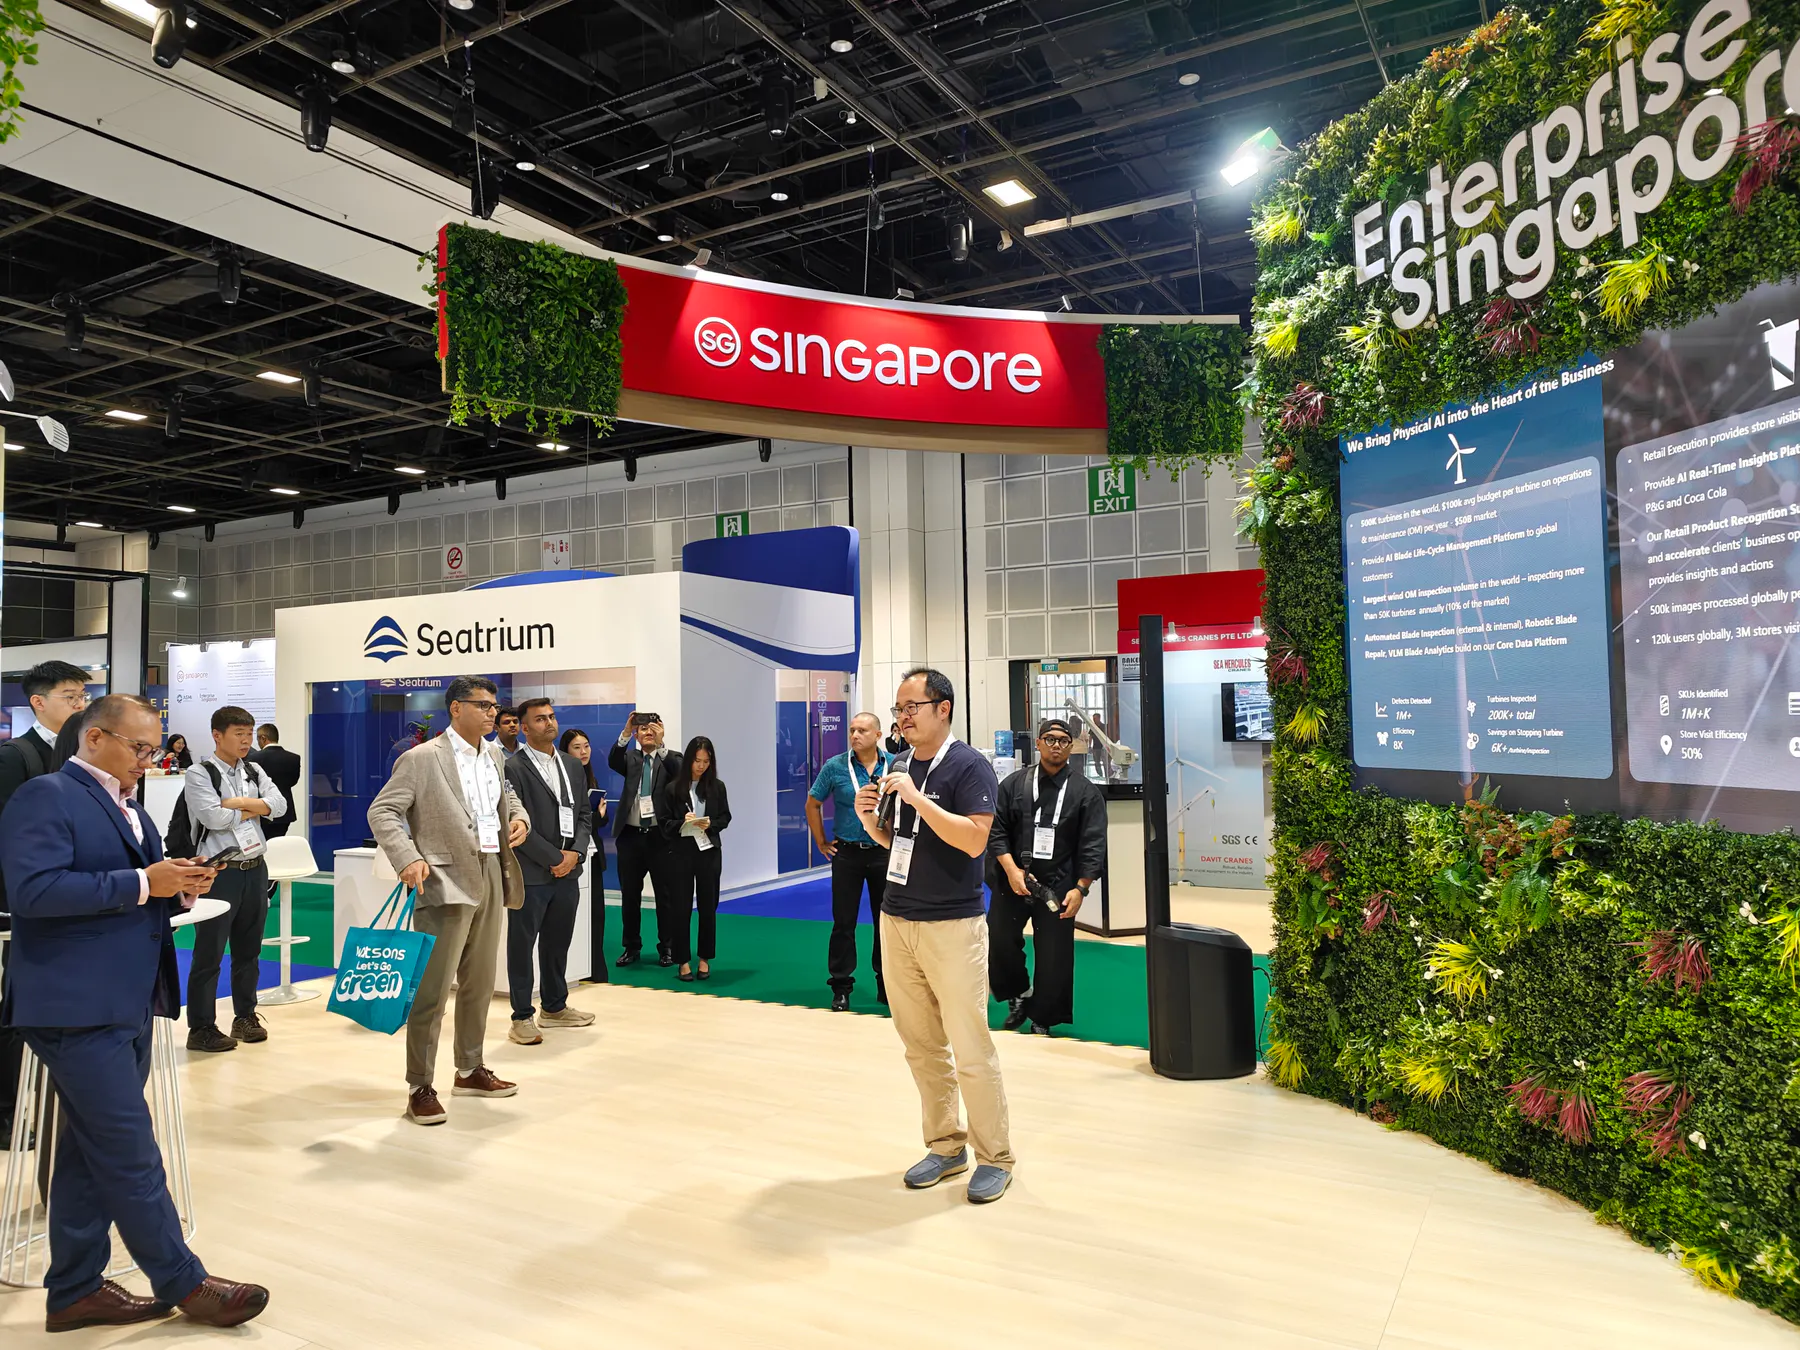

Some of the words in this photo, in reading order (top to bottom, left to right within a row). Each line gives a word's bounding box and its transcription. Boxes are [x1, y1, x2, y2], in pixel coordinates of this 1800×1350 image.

[1353, 0, 1751, 285] Enterprise
[1392, 37, 1800, 330] Singapor
[1347, 441, 1363, 453] We
[1365, 433, 1391, 448] Bring
[1393, 418, 1432, 440] Physical
[1447, 409, 1468, 424] into
[1471, 402, 1489, 416] the
[1491, 389, 1522, 410] Heart
[1525, 382, 1538, 399] of
[1539, 379, 1559, 394] the
[1562, 359, 1615, 387] Business
[1643, 447, 1666, 462] Retail
[1667, 437, 1708, 456] Execution
[1710, 426, 1750, 447] provides
[1751, 419, 1776, 433] store
[1645, 475, 1675, 491] Provide
[1689, 461, 1737, 481] Real-Time
[1739, 451, 1779, 469] Insights
[1093, 496, 1130, 513] EXIT
[1378, 513, 1403, 524] turbines
[1411, 508, 1421, 518] the
[1422, 504, 1441, 515] world,
[1441, 499, 1463, 512] $100k
[1463, 497, 1476, 507] avg
[1477, 490, 1501, 502] budget
[1502, 488, 1515, 499] per
[1515, 481, 1541, 494] turbine
[1552, 469, 1593, 486] operations
[1645, 500, 1665, 513] P&G
[1666, 496, 1682, 509] and
[1684, 493, 1705, 505] Coca
[1707, 486, 1728, 499] Cola
[1368, 530, 1406, 543] maintenance
[1407, 525, 1423, 537] (OM)
[1424, 525, 1434, 535] per
[1435, 521, 1449, 532] year
[1454, 514, 1472, 527] $50B
[1473, 510, 1498, 522] market
[1646, 532, 1663, 543] Our
[1664, 525, 1690, 540] Retail
[1691, 518, 1729, 534] Product
[1362, 555, 1385, 566] Provide
[1394, 551, 1413, 561] Blade
[1413, 544, 1445, 558] Life-Cycle
[1446, 536, 1492, 552] Management
[1493, 530, 1525, 543] Platform
[1535, 522, 1558, 538] global
[1648, 552, 1663, 564] and
[1665, 545, 1711, 562] accelerate
[1745, 533, 1786, 548] business
[1362, 572, 1394, 582] customers
[1648, 572, 1684, 588] provides
[1685, 567, 1719, 581] insights
[1720, 562, 1738, 576] and
[1740, 559, 1774, 573] actions
[1363, 595, 1387, 605] Largest
[1387, 592, 1404, 601] wind
[1418, 585, 1452, 598] inspection
[1453, 582, 1479, 592] volume
[1488, 578, 1500, 588] the
[1500, 574, 1521, 585] world
[1527, 569, 1564, 583] inspecting
[1565, 567, 1585, 576] more
[1363, 612, 1377, 620] than
[1378, 611, 1390, 619] 50K
[1391, 608, 1417, 618] turbines
[1418, 604, 1445, 615] annually
[1445, 601, 1462, 613] (10%
[1471, 599, 1483, 609] the
[1484, 596, 1510, 607] market)
[1650, 603, 1670, 615] 500k
[1671, 602, 1702, 614] images
[1704, 594, 1749, 612] processed
[1751, 589, 1789, 607] globally
[416, 617, 555, 657] Seatrium
[1187, 634, 1219, 642] CRANES
[1364, 632, 1400, 643] Automated
[1401, 631, 1420, 640] Blade
[1421, 628, 1455, 639] Inspection
[1456, 624, 1485, 636] (external
[1525, 617, 1554, 628] Robotic
[1555, 614, 1578, 625] Blade
[1652, 633, 1671, 645] 120k
[1673, 633, 1695, 644] users
[1697, 628, 1734, 644] globally,
[1735, 626, 1751, 638] 3M
[1753, 625, 1782, 637] stores
[1388, 649, 1403, 658] VLM
[1404, 648, 1423, 657] Blade
[1424, 645, 1454, 656] Analytics
[1455, 643, 1471, 653] build
[1483, 642, 1496, 651] our
[1496, 641, 1514, 650] Core
[1515, 640, 1533, 649] Data
[1534, 636, 1568, 647] Platform
[1213, 659, 1224, 670] SEA
[1225, 658, 1251, 669] HERCULES
[399, 677, 442, 687] Seatrium
[1410, 697, 1432, 705] Detected
[1487, 695, 1510, 703] Turbines
[1510, 694, 1537, 704] Inspected
[1678, 690, 1695, 699] SKUs
[1696, 689, 1729, 698] Identified
[1396, 710, 1412, 720] 1M+
[1487, 710, 1514, 720] 200K+
[1516, 709, 1536, 720] total
[1681, 707, 1712, 720] 1M+K
[1392, 727, 1415, 736] Efficiency
[1487, 728, 1508, 738] Savings
[1517, 728, 1542, 738] Stopping
[1542, 728, 1564, 737] Turbine
[1680, 730, 1698, 739] Store
[1699, 730, 1714, 739] Visit
[1715, 730, 1748, 742] Efficiency
[1491, 743, 1508, 753] 6K+
[1681, 747, 1703, 760] 50%
[1221, 834, 1241, 845] SGS
[1200, 855, 1222, 863] DAVIT
[1223, 856, 1253, 865] CRANES
[336, 969, 403, 1002] Green
